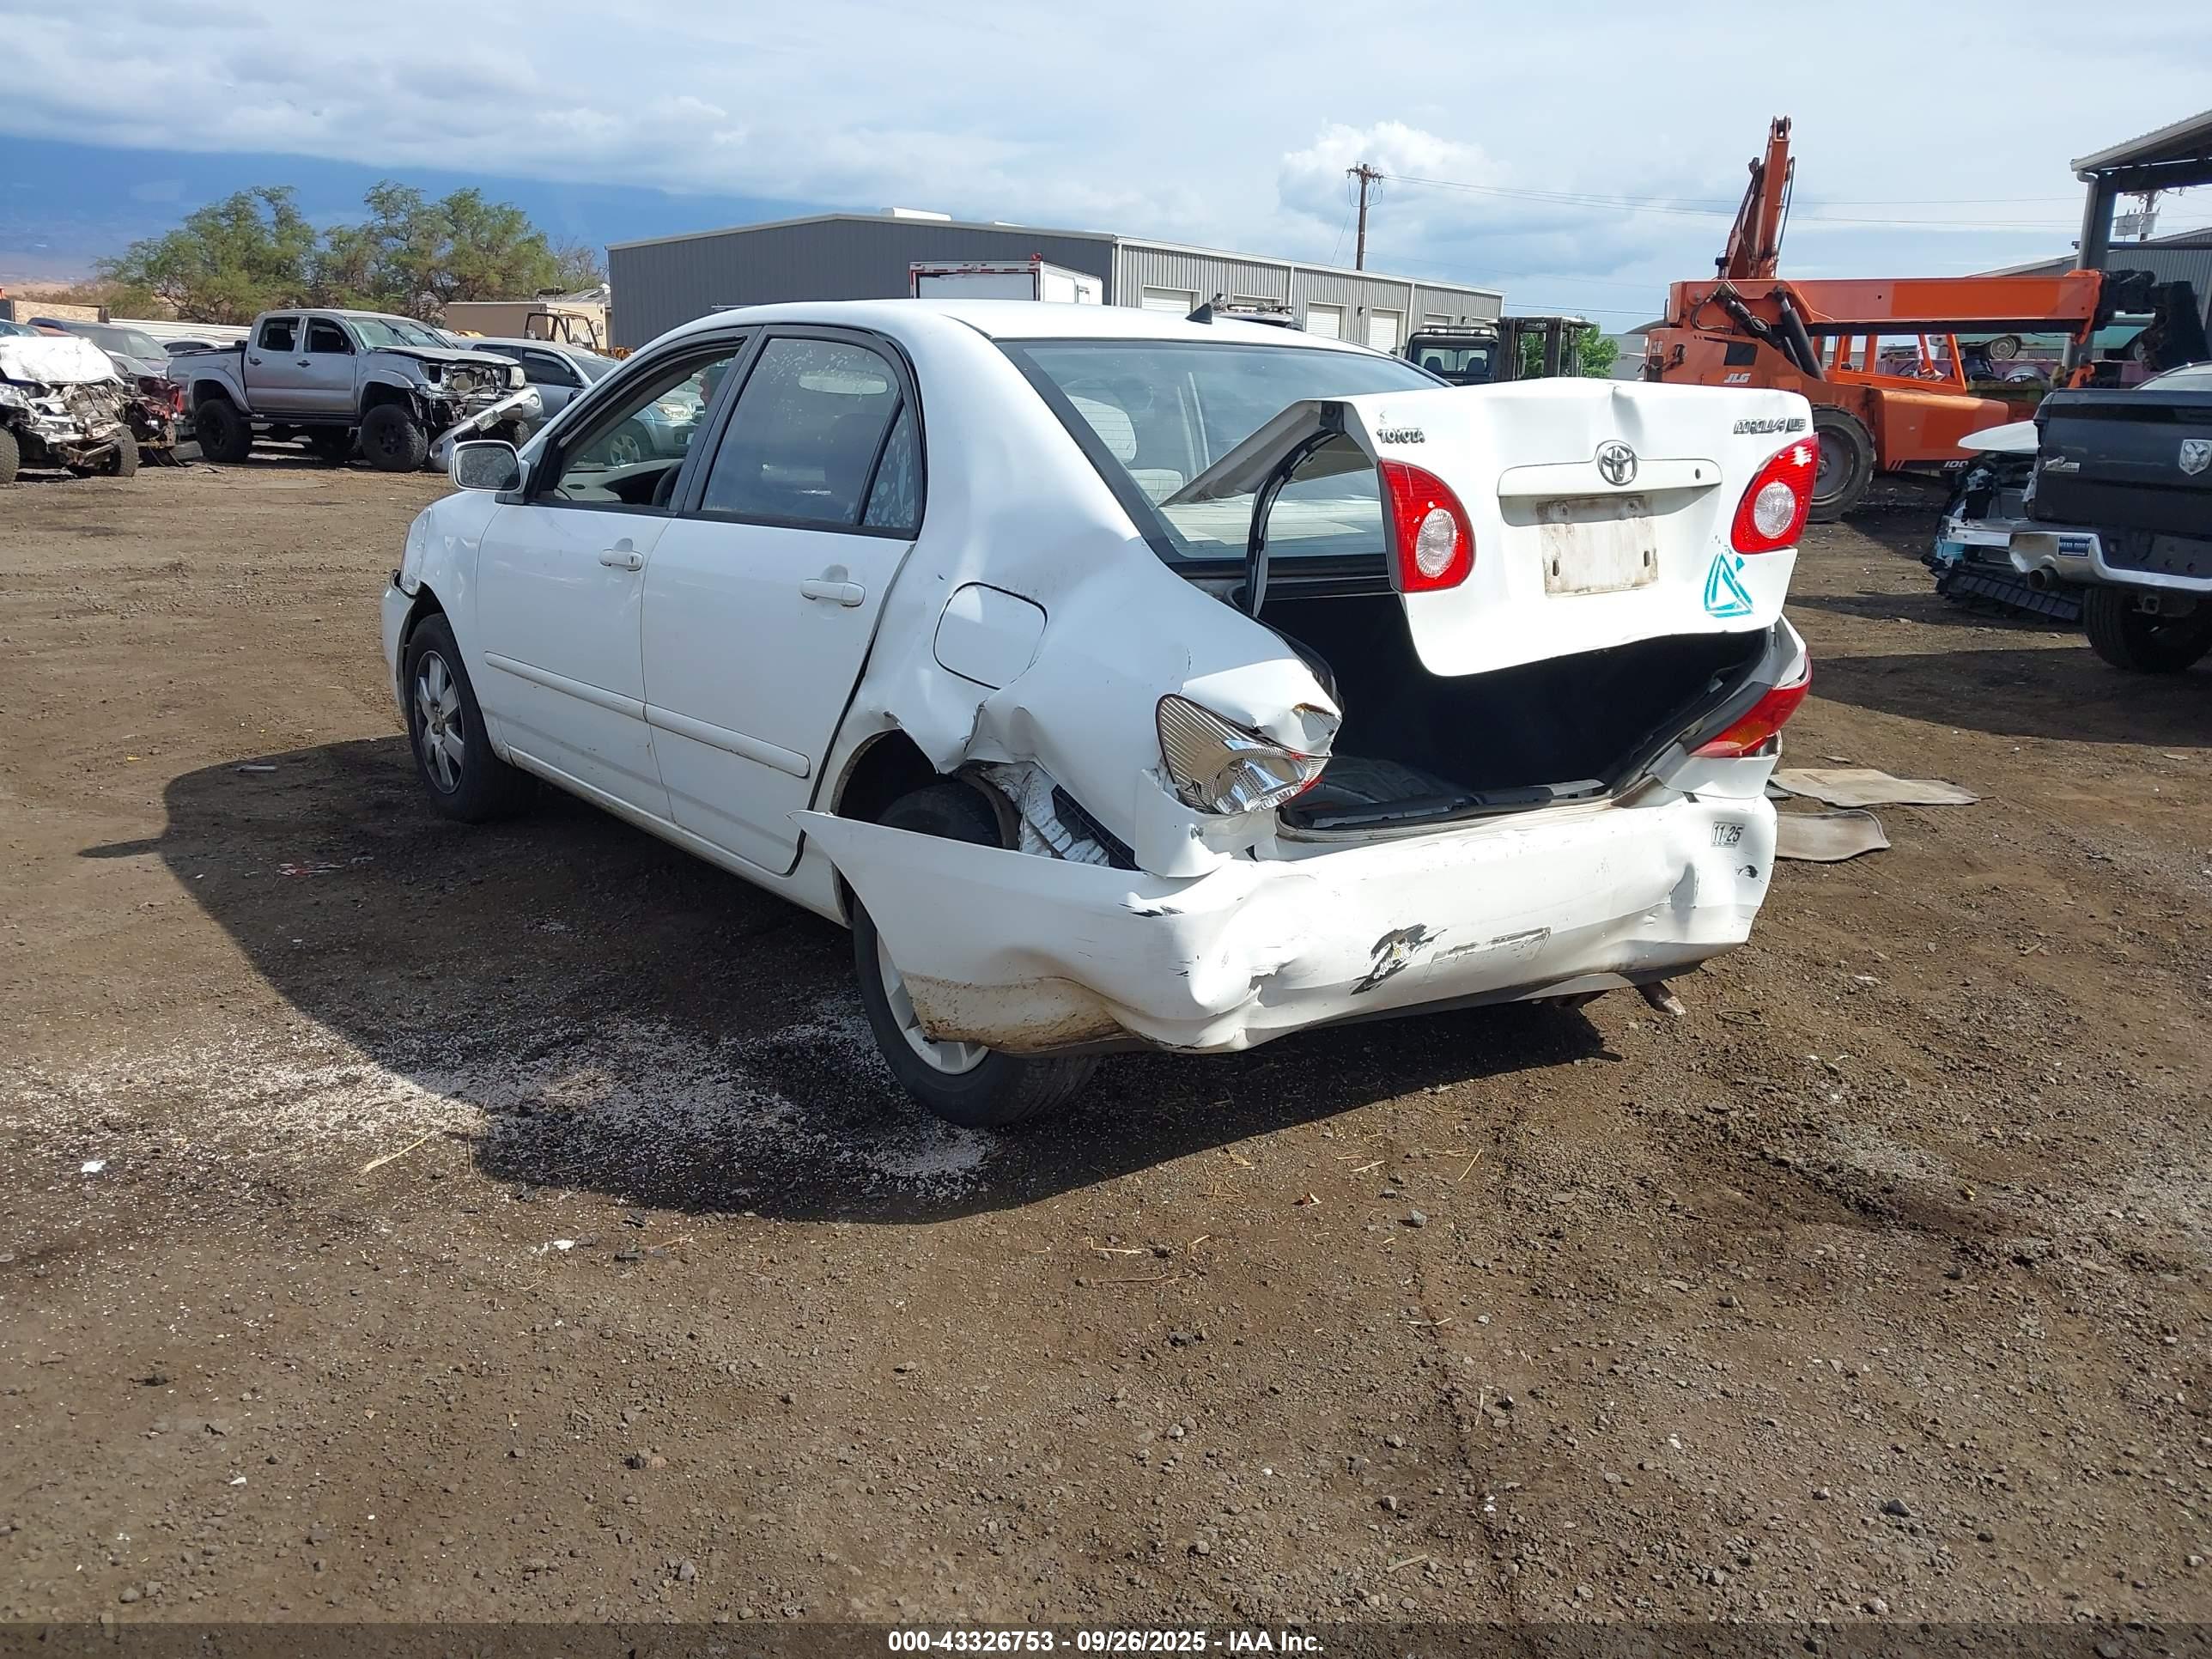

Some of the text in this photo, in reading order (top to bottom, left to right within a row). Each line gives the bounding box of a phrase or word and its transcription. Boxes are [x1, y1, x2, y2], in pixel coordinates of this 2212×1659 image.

[1723, 373, 1751, 383] JLG
[1785, 417, 1807, 434] LE
[1376, 428, 1425, 444] TOYOTA
